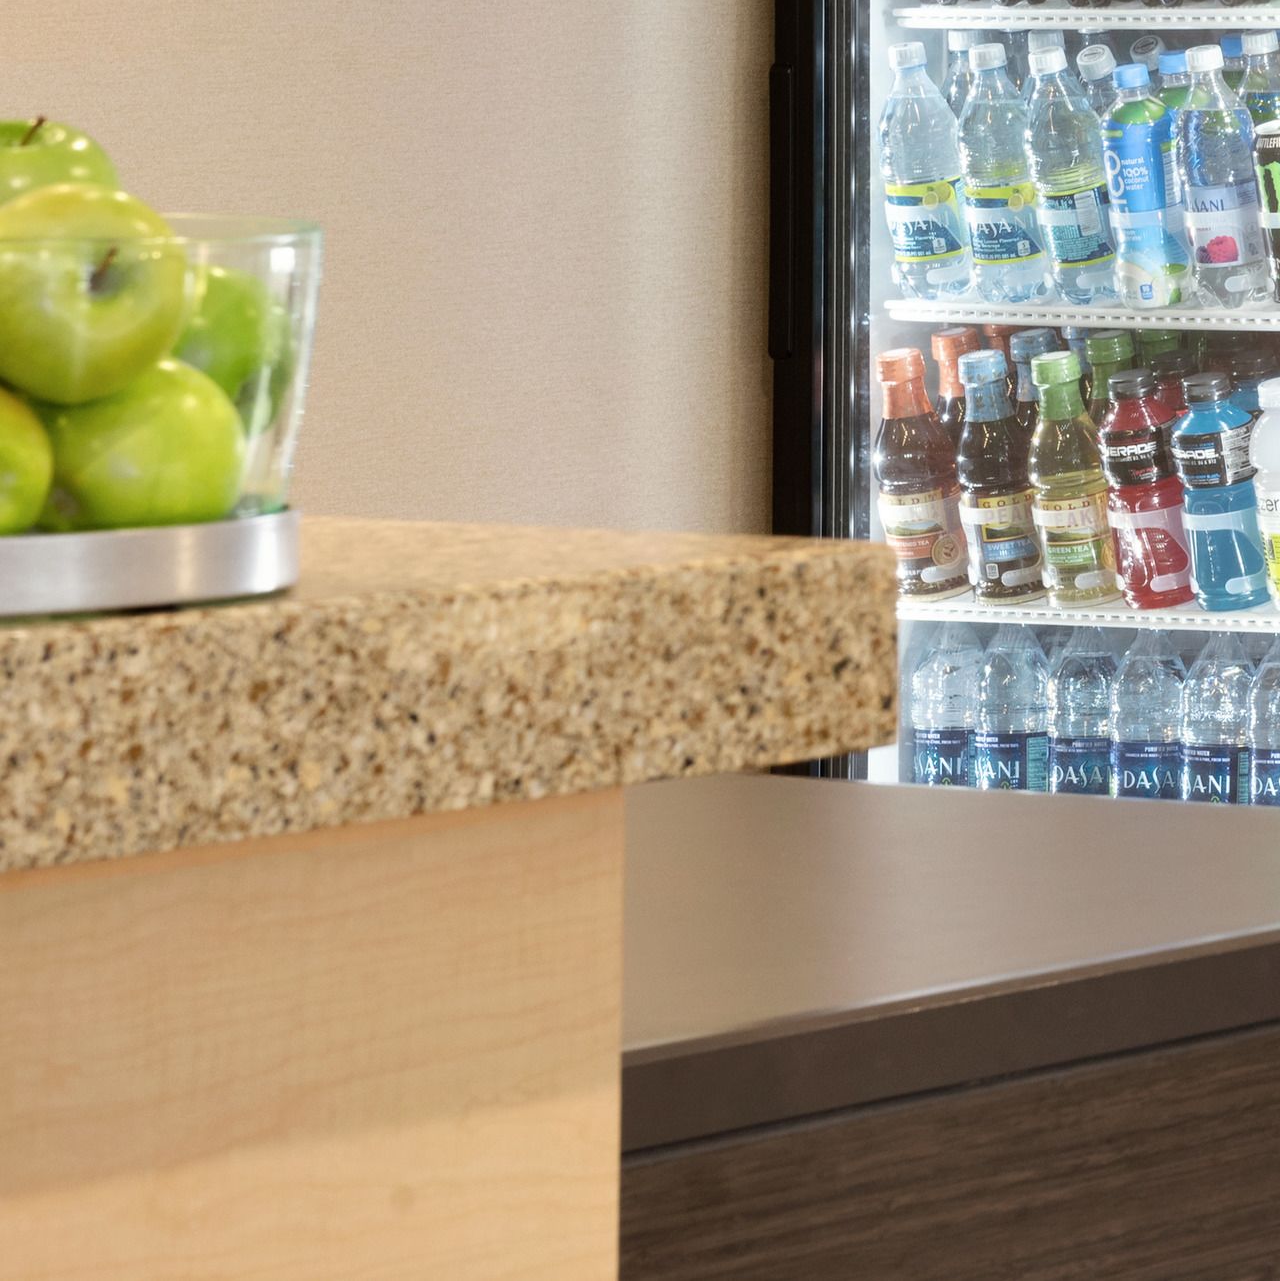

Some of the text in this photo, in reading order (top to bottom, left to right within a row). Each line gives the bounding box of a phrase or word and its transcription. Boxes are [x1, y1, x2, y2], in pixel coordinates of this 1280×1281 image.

[1120, 156, 1145, 165] natural
[1122, 167, 1149, 177] 100%
[982, 493, 1034, 508] GOLD
[1041, 500, 1091, 512] GOLD
[1071, 545, 1090, 553] TEA
